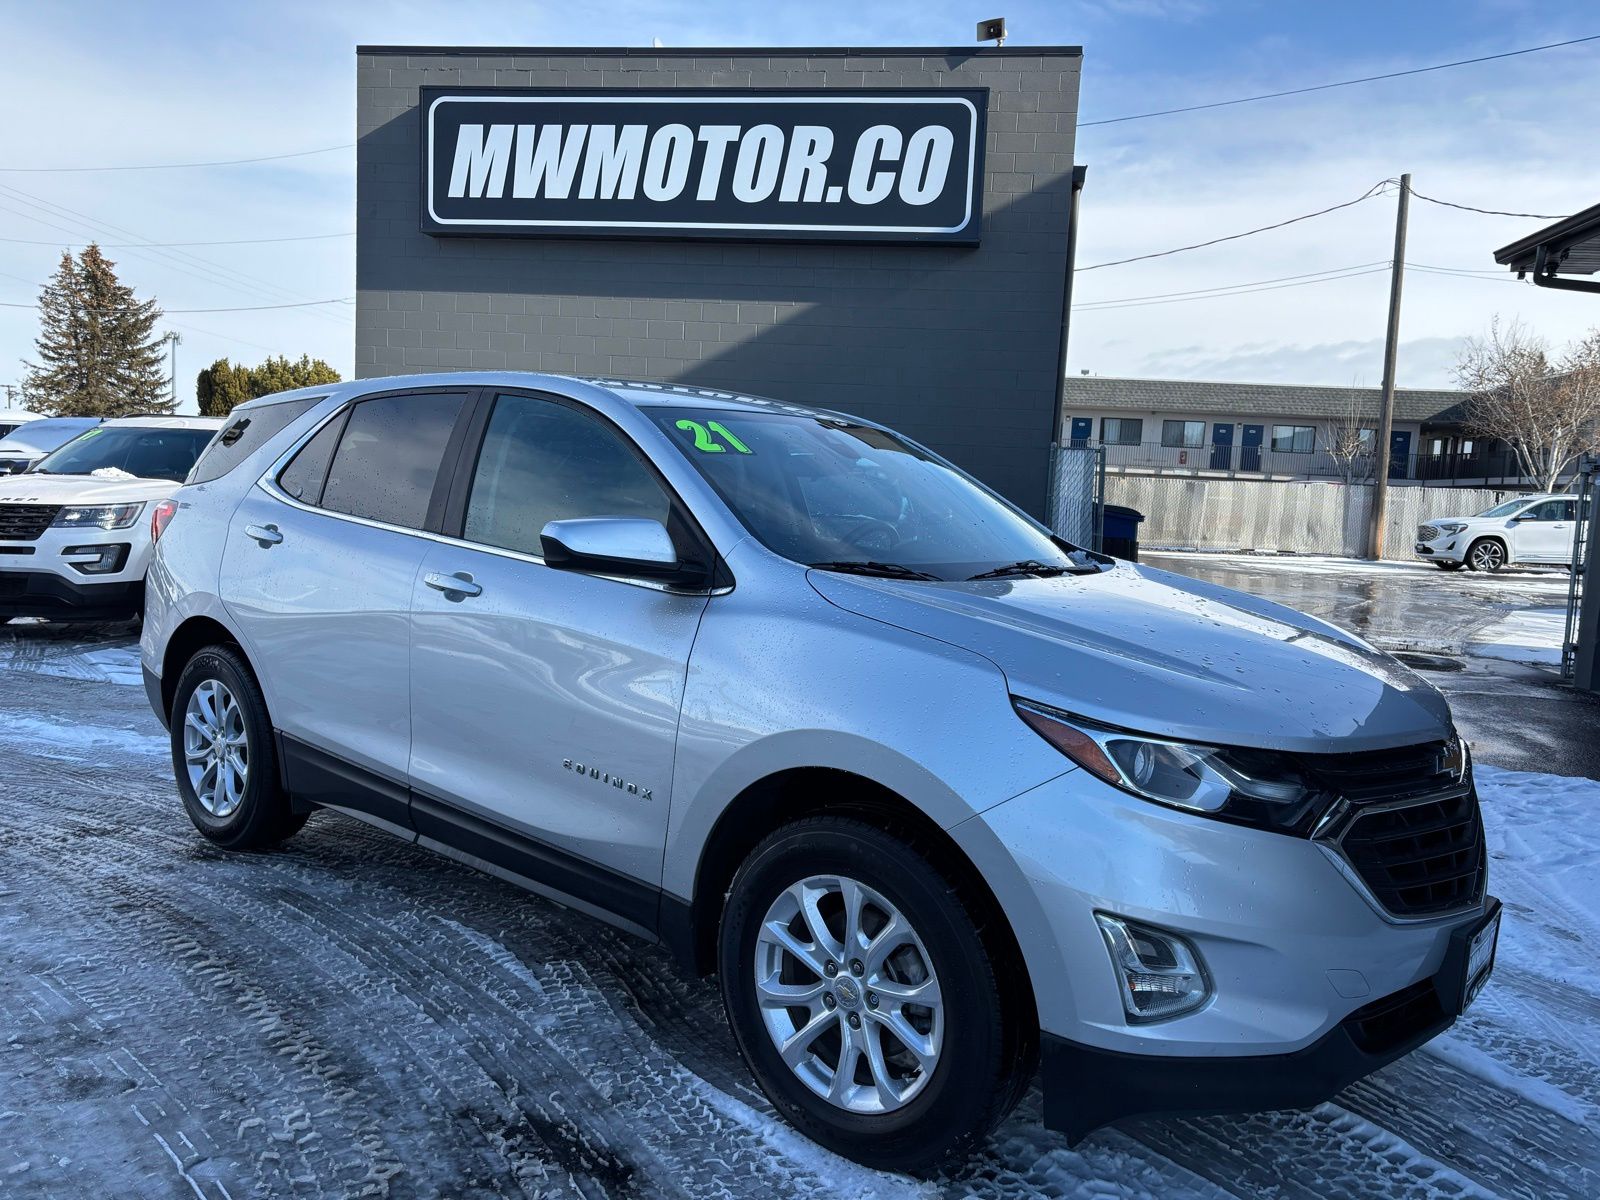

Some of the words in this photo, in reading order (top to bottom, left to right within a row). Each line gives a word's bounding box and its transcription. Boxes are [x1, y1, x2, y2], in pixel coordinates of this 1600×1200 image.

[447, 123, 954, 206] MWMOTOR.CO
[675, 419, 754, 454] 21
[562, 758, 653, 801] EQUINOX
